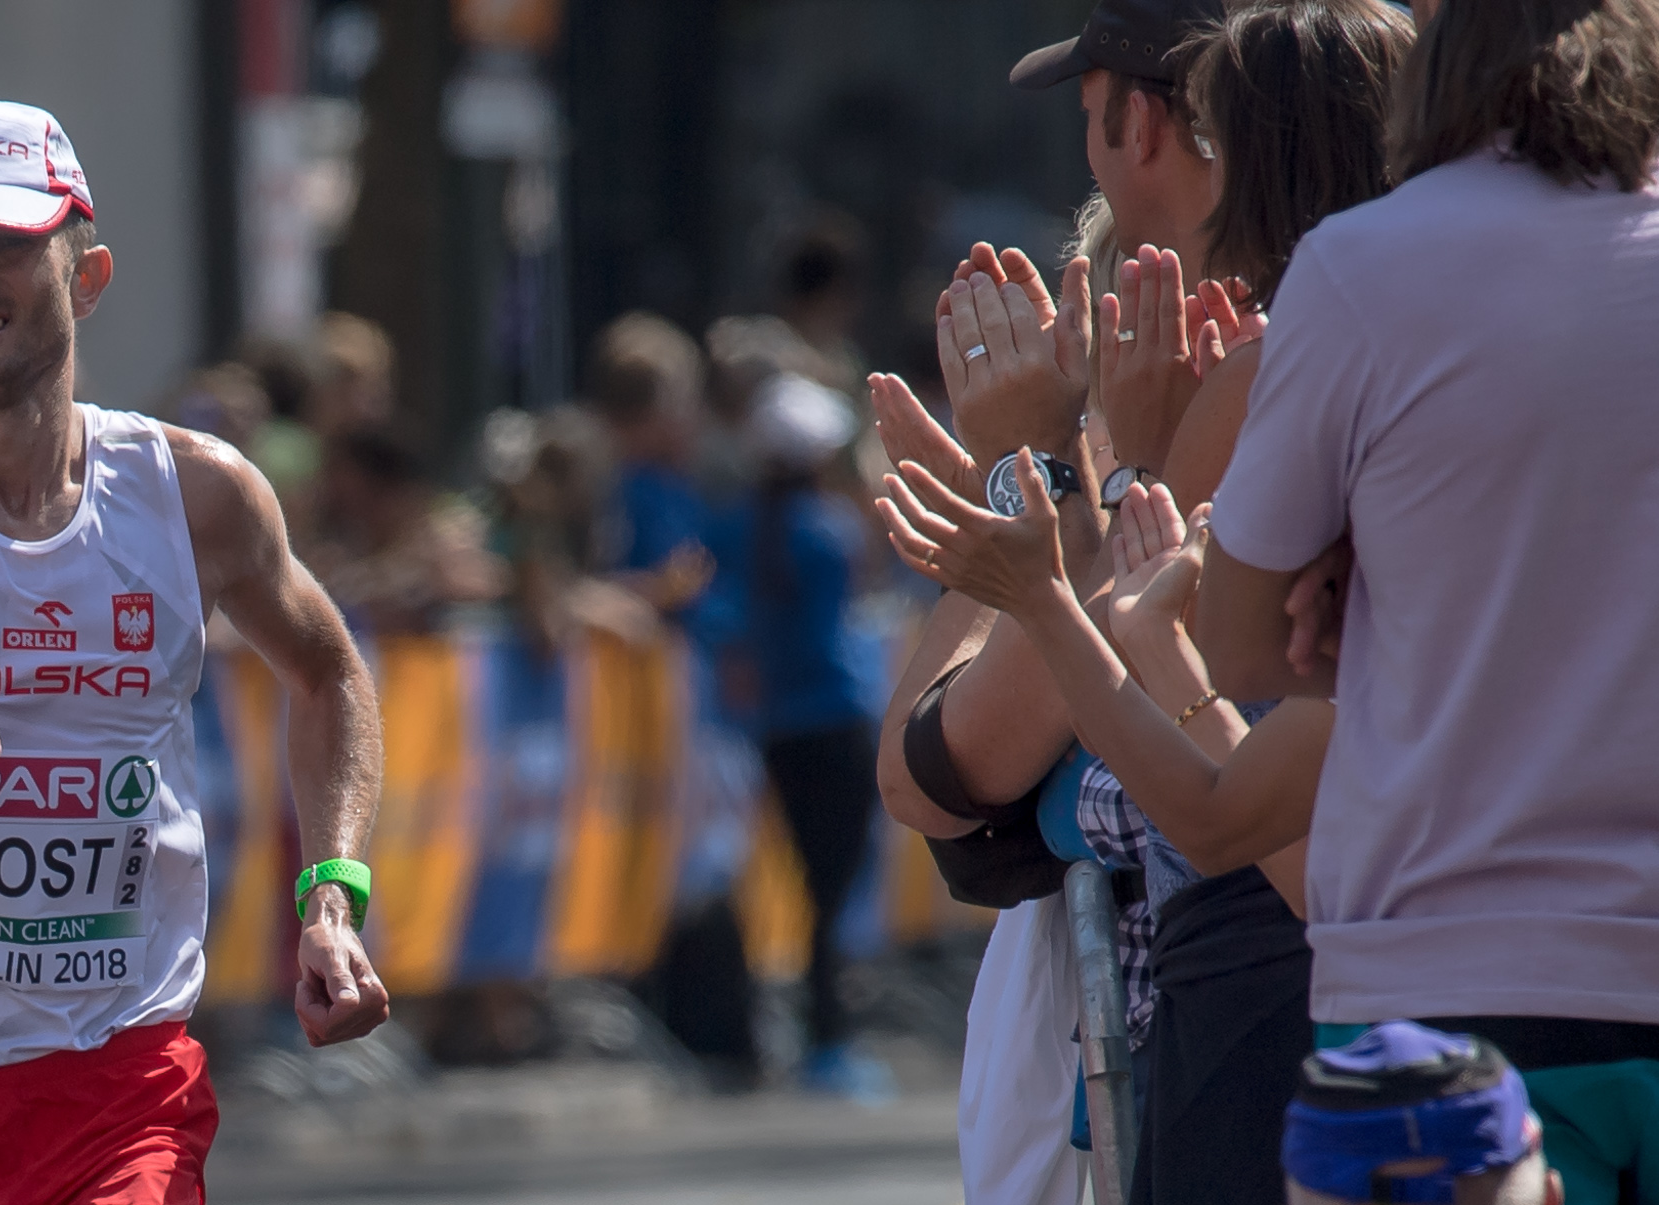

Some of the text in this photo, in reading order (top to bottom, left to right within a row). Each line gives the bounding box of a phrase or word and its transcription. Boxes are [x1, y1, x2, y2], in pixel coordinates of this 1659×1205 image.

[115, 596, 151, 604] POLSKA
[6, 630, 72, 649] ORLEN
[54, 948, 127, 984] 2018
